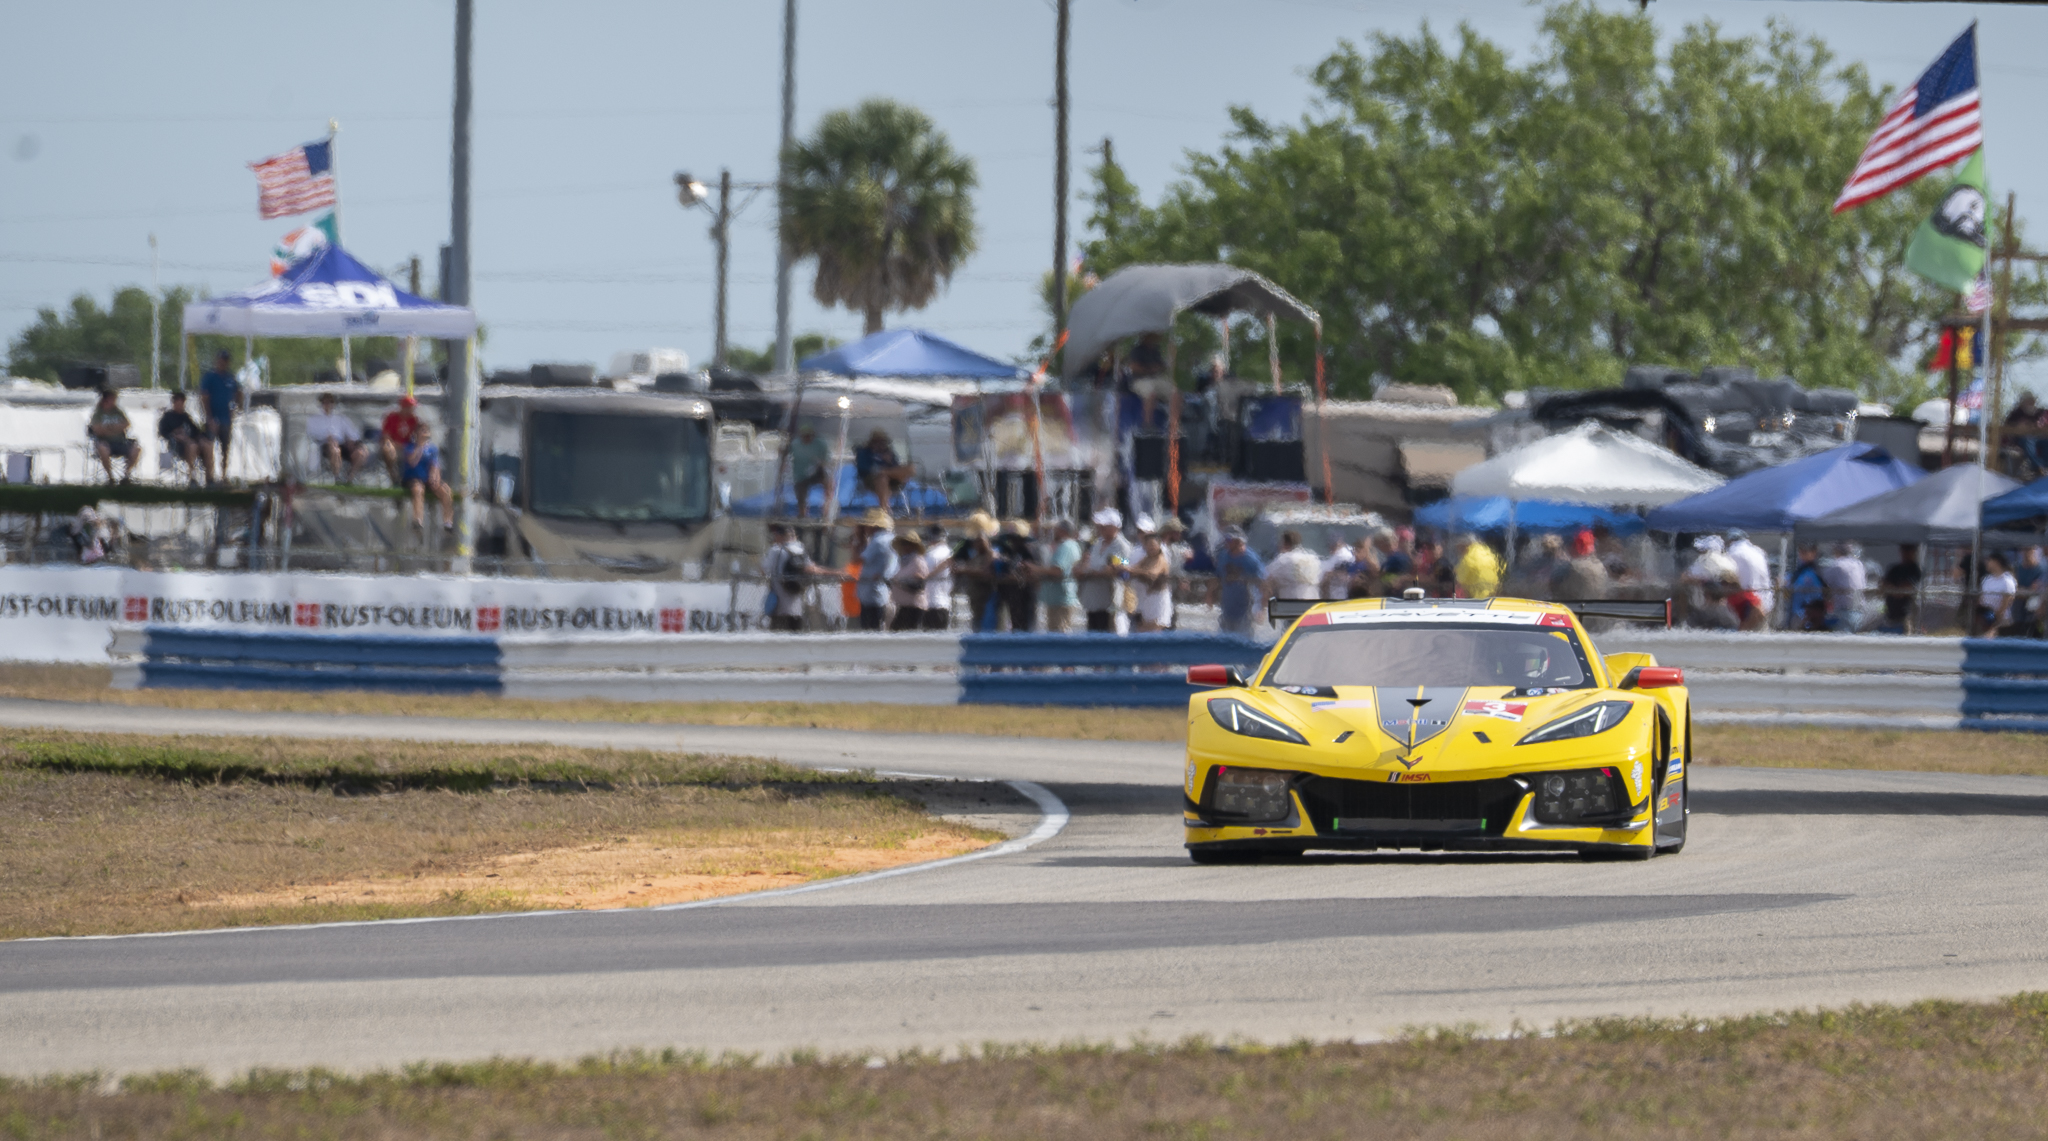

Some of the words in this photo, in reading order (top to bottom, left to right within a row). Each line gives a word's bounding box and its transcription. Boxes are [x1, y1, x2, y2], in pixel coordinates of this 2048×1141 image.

[152, 597, 292, 624] RUST-OLEUM
[324, 603, 472, 630] RUST-OLEUM
[504, 606, 655, 630] RUST-OLEUM
[1401, 773, 1431, 782] IMSA
